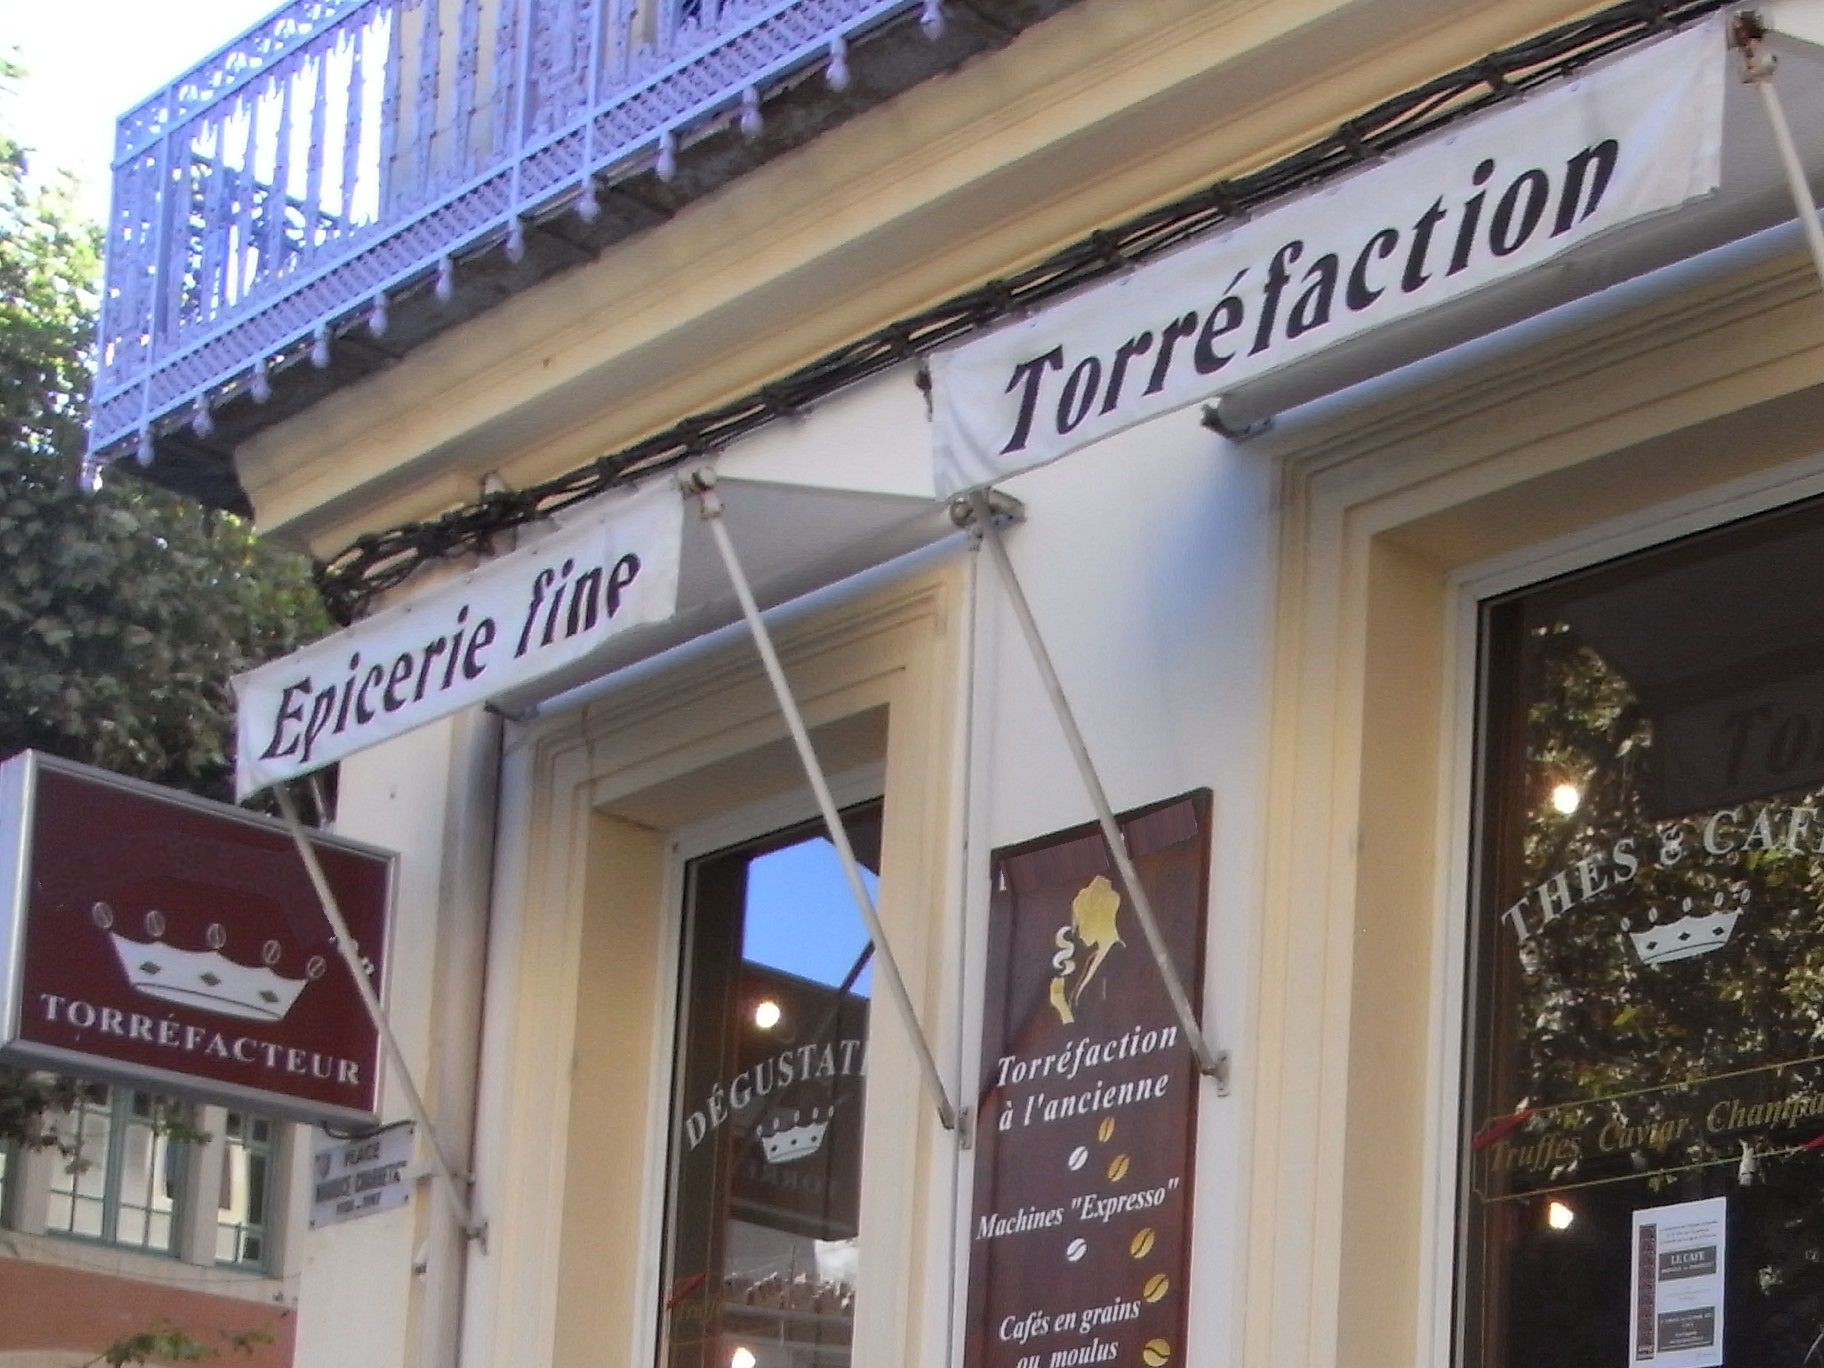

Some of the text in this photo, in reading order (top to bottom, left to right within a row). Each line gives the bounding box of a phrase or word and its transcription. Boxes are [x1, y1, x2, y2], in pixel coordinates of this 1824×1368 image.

[1000, 137, 1620, 455] Torréfaction
[261, 552, 642, 763] Epicerie fine
[1501, 837, 1638, 944] THES
[41, 993, 360, 1086] TORRÉFACTEUR
[997, 1025, 1178, 1087] Torréfaction
[998, 1073, 1170, 1131] à l'ancienne
[976, 1177, 1180, 1240] Machines "Expresso"
[999, 1297, 1142, 1344] Cafés en grains
